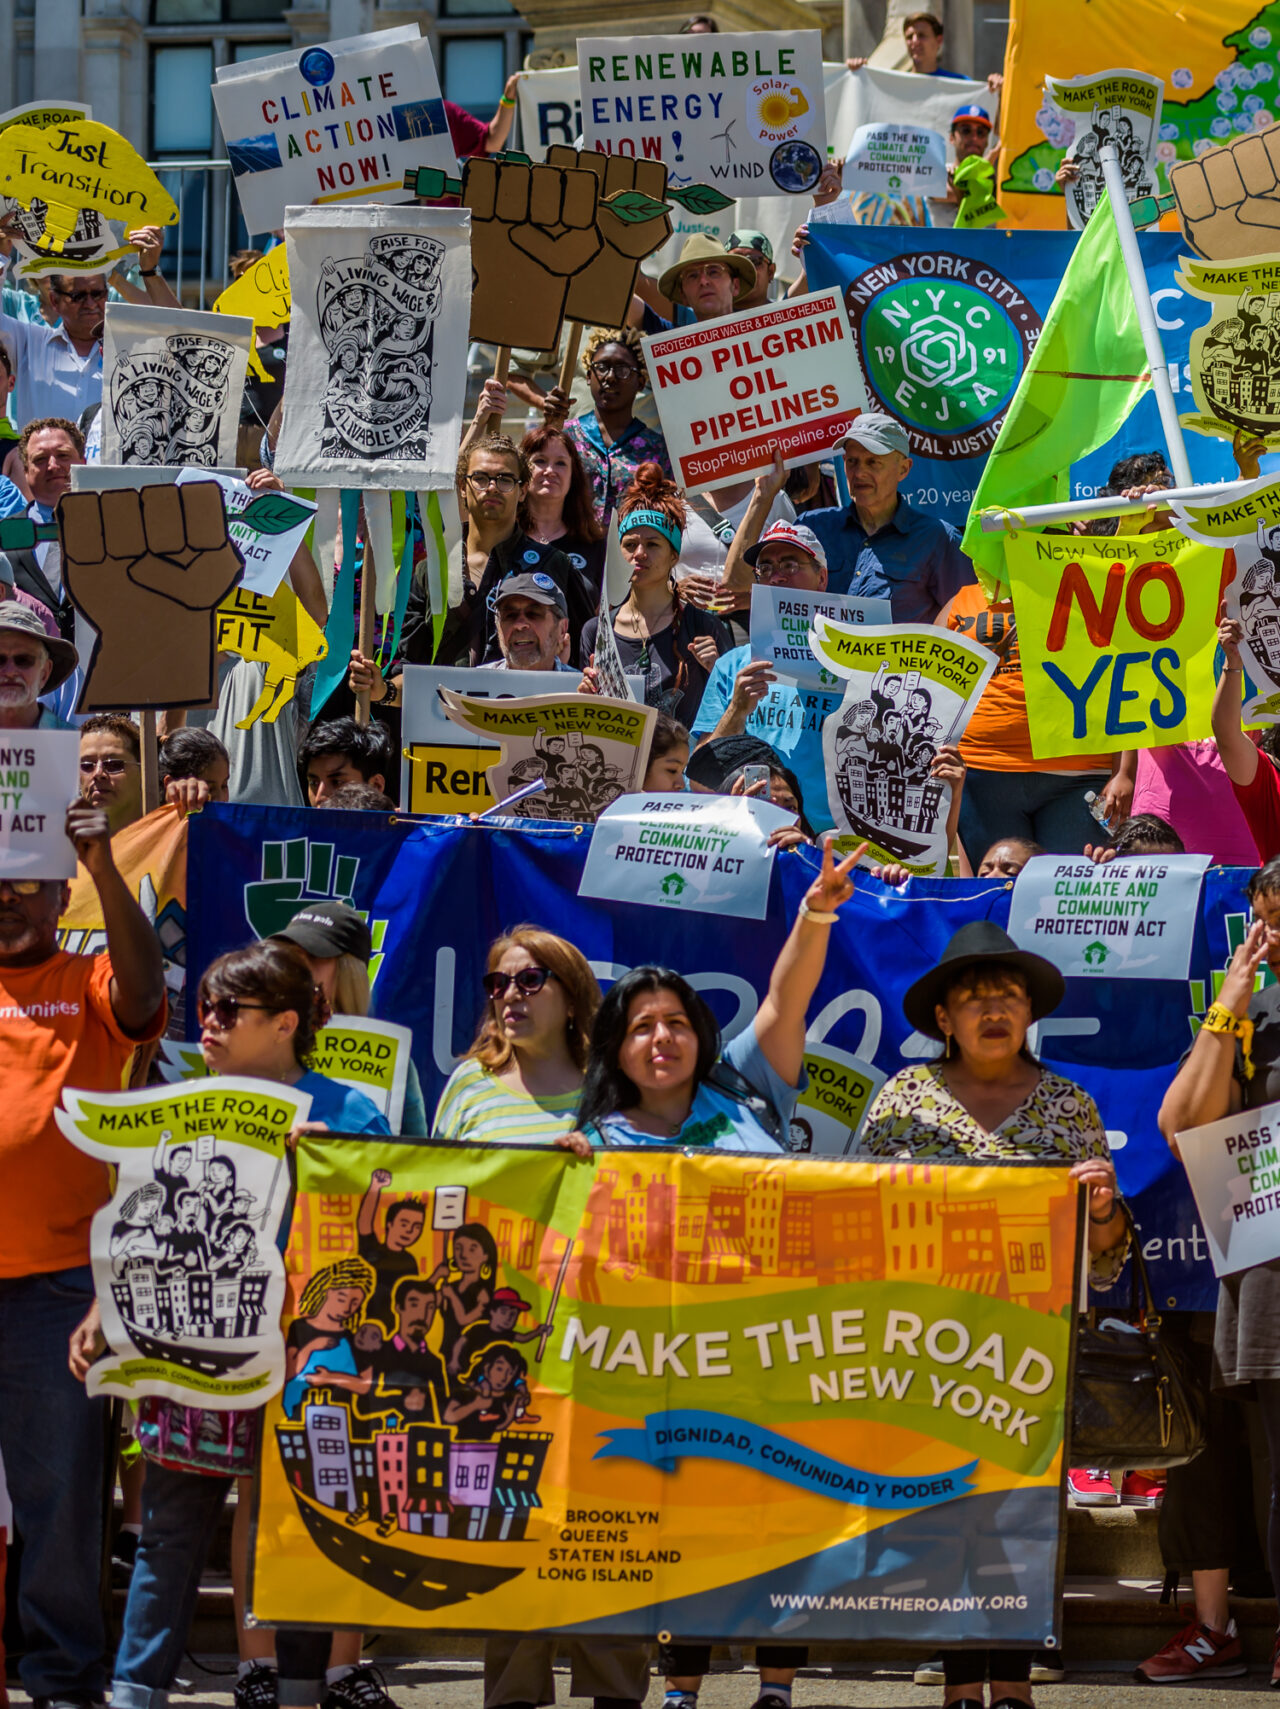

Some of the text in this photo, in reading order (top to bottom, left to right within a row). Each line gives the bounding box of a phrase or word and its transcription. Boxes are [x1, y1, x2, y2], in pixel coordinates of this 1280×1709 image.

[589, 49, 796, 83] RENEWABLE
[261, 72, 398, 124] CLIMATE
[752, 78, 790, 96] Solar
[1063, 82, 1155, 102] MAKE THE ROAD
[592, 92, 724, 124] ENERGY
[1105, 95, 1152, 111] NEW YORK
[288, 112, 395, 159] ACTION
[759, 123, 800, 142] power
[866, 131, 930, 144] PASS THE NYS
[49, 129, 113, 170] Just
[867, 142, 926, 154] CLIMATE AND
[870, 152, 922, 163] COMMUNITY
[14, 149, 148, 213] Transition
[316, 153, 392, 191] NOW!
[709, 162, 764, 180] WIND
[858, 162, 932, 175] PROTECTION ACT
[380, 235, 437, 252] RISE FOR
[339, 266, 425, 313] LIVING WAGE
[851, 256, 1025, 308] NEW YORK CITY
[1203, 271, 1248, 284] MAKE
[653, 299, 835, 356] PROTECT OUR WATER PUBLIC HEALTH
[176, 336, 228, 353] RISE FOR
[656, 317, 844, 389] NO PILGRIM
[133, 362, 213, 408] LIVING WAGE
[729, 367, 787, 400] OIL
[690, 384, 839, 446] PIPELINES
[342, 417, 394, 447] LIVABLE
[1206, 505, 1254, 526] MAKE
[244, 545, 272, 562] ACT
[1036, 541, 1085, 560] New
[1093, 543, 1138, 560] York
[1046, 561, 1185, 652] NO
[790, 694, 833, 712] ARE
[1042, 648, 1187, 739] YES
[639, 830, 730, 853] COMMUNITY
[615, 845, 745, 875] PROTECTION ACT
[1034, 919, 1129, 936] PROTECTION
[99, 1097, 288, 1131] MAKE THE ROAD
[185, 1117, 283, 1147] NEW YORK
[1224, 1127, 1272, 1156] PASS
[560, 1308, 1056, 1397] MAKE THE ROAD
[808, 1366, 1042, 1447] NEW YORK
[655, 1427, 955, 1500] DIGNIDAD, COMUNIDAD Y PODER
[565, 1509, 660, 1526] BROOKLYN
[559, 1528, 629, 1545] QUEENS
[548, 1547, 682, 1565] STATEN ISLAND
[537, 1567, 654, 1583] LONG ISLAND
[769, 1592, 1029, 1612] WWW.MAKETHEROADNY.ORG
